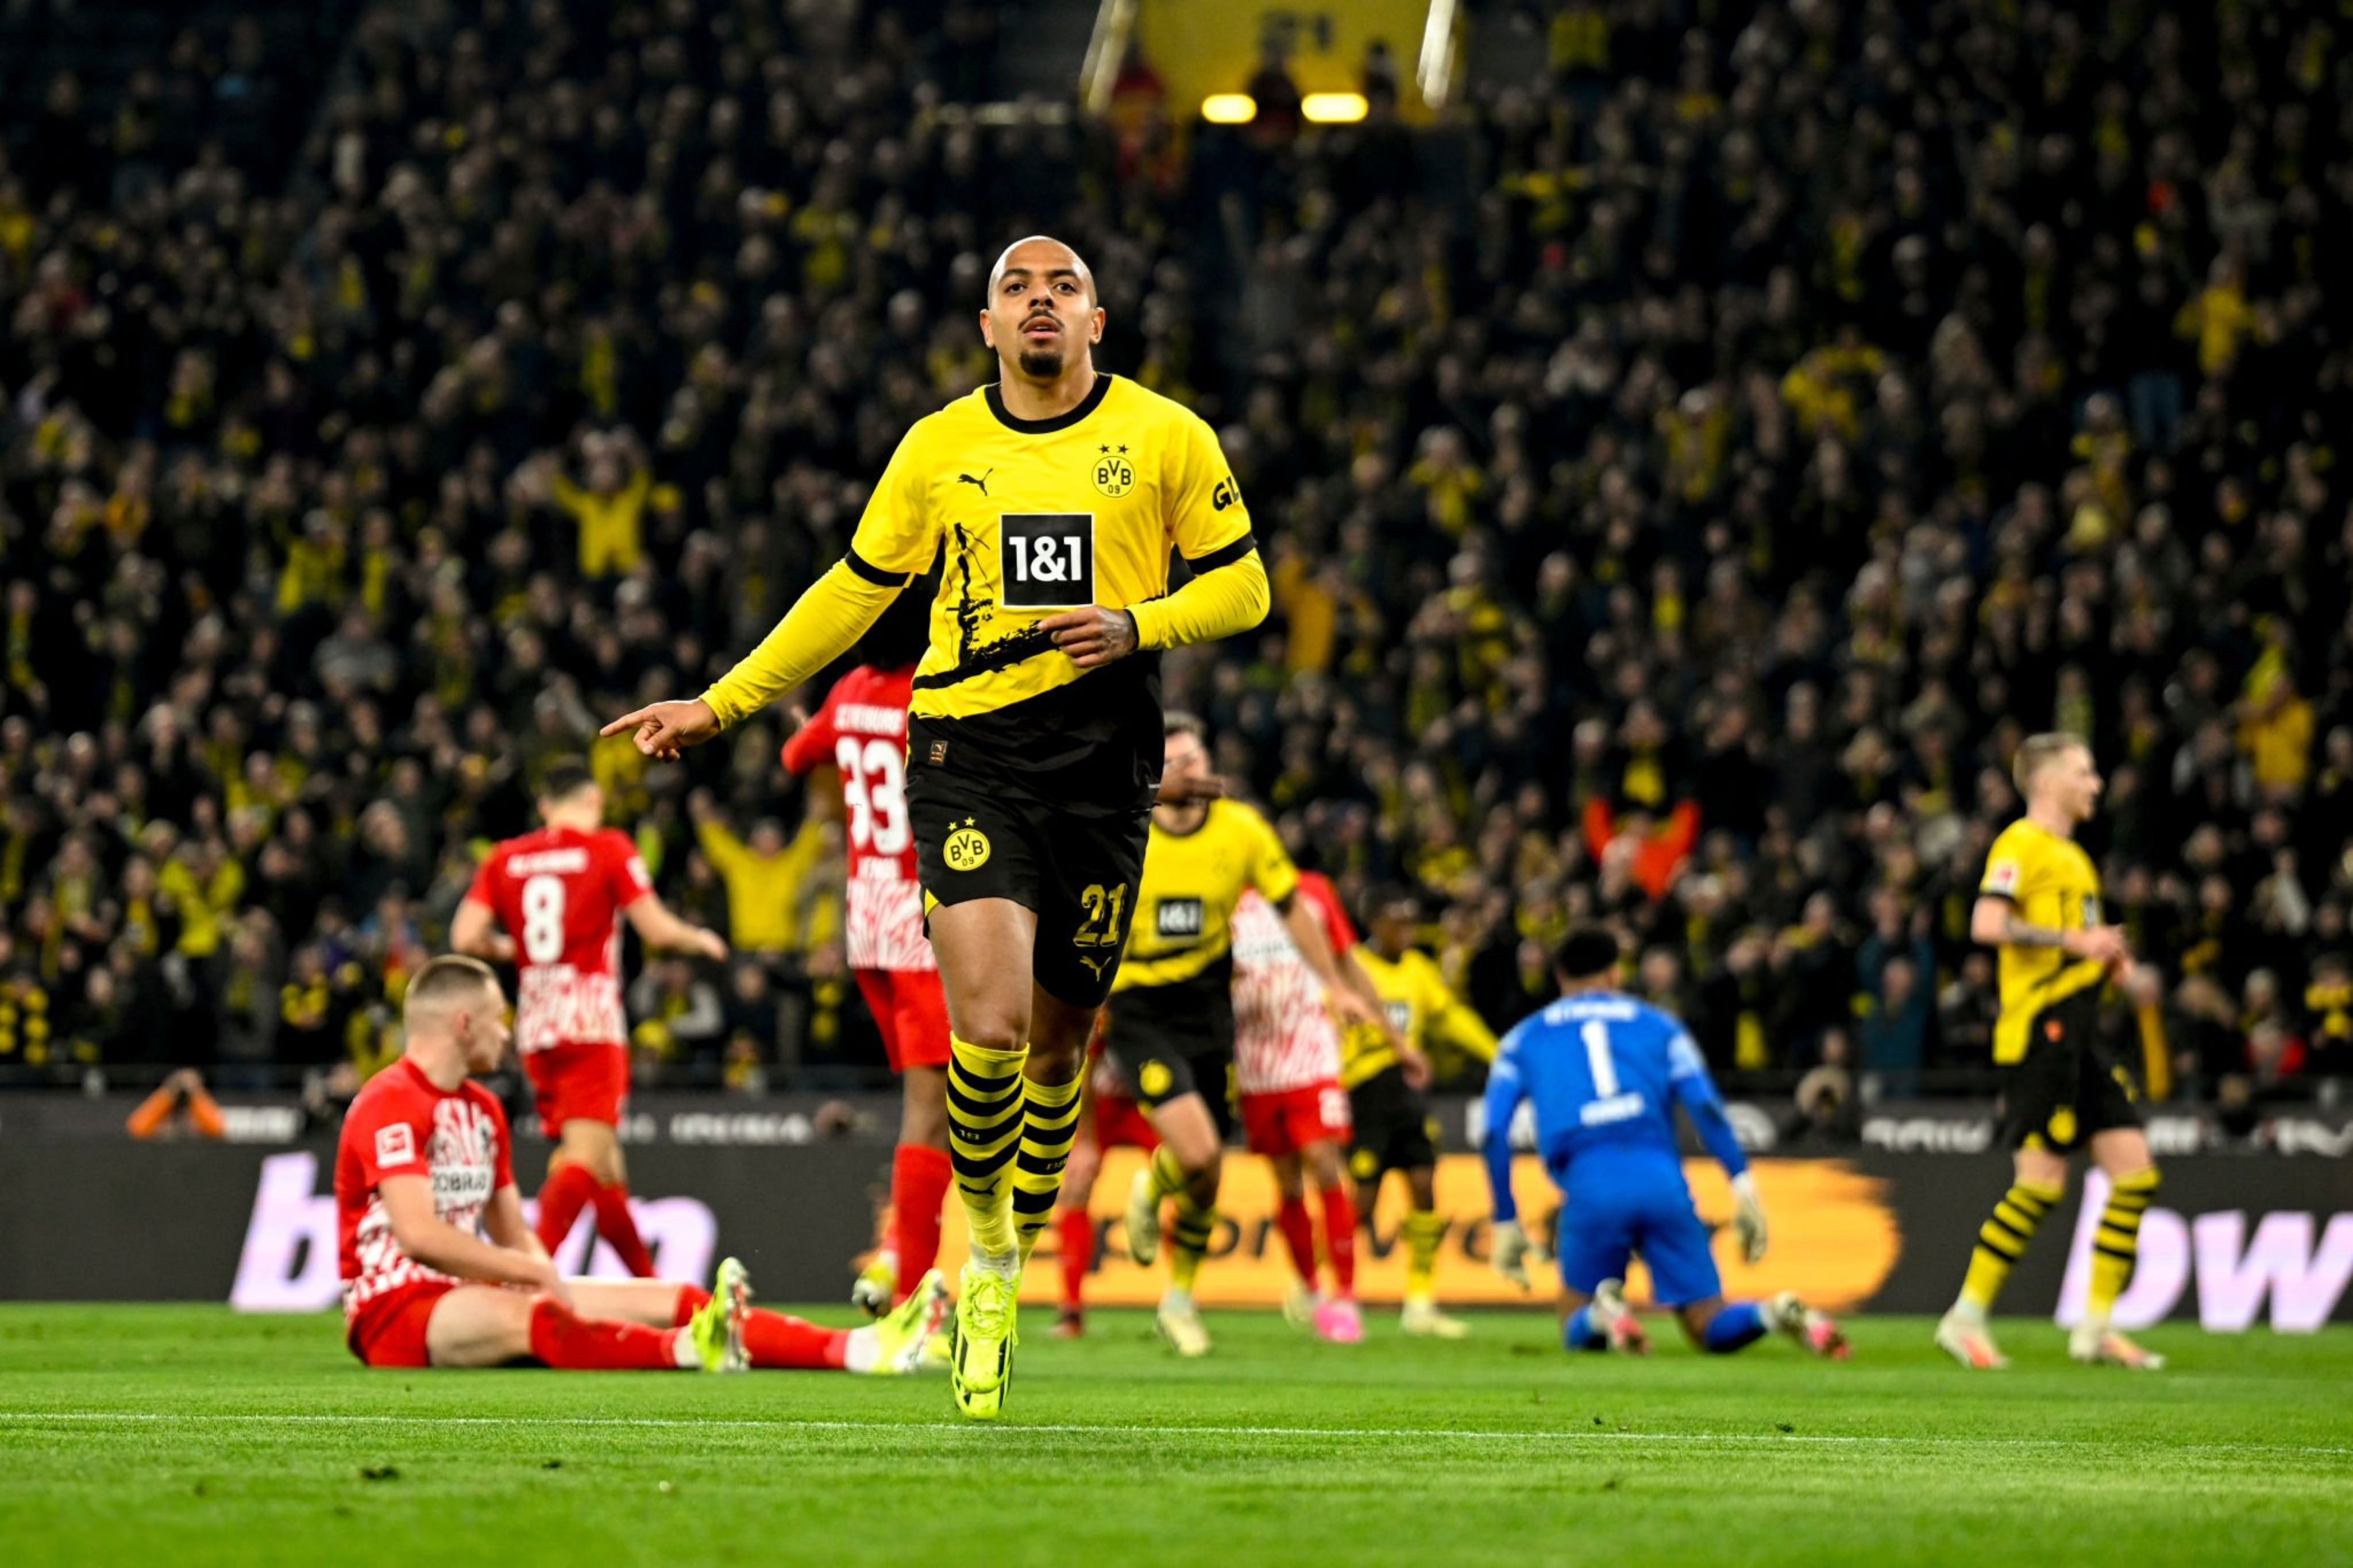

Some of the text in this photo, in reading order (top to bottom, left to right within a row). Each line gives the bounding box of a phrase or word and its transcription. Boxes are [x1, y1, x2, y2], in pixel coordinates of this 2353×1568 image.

[1098, 460, 1131, 485] BVB
[1108, 484, 1120, 494] 09
[1009, 536, 1082, 582] 1&1
[836, 735, 908, 855] 33
[950, 834, 984, 862] BVB
[962, 856, 975, 867] 09
[522, 873, 566, 964] 8
[1073, 883, 1127, 947] 21
[1581, 1019, 1619, 1098] 1
